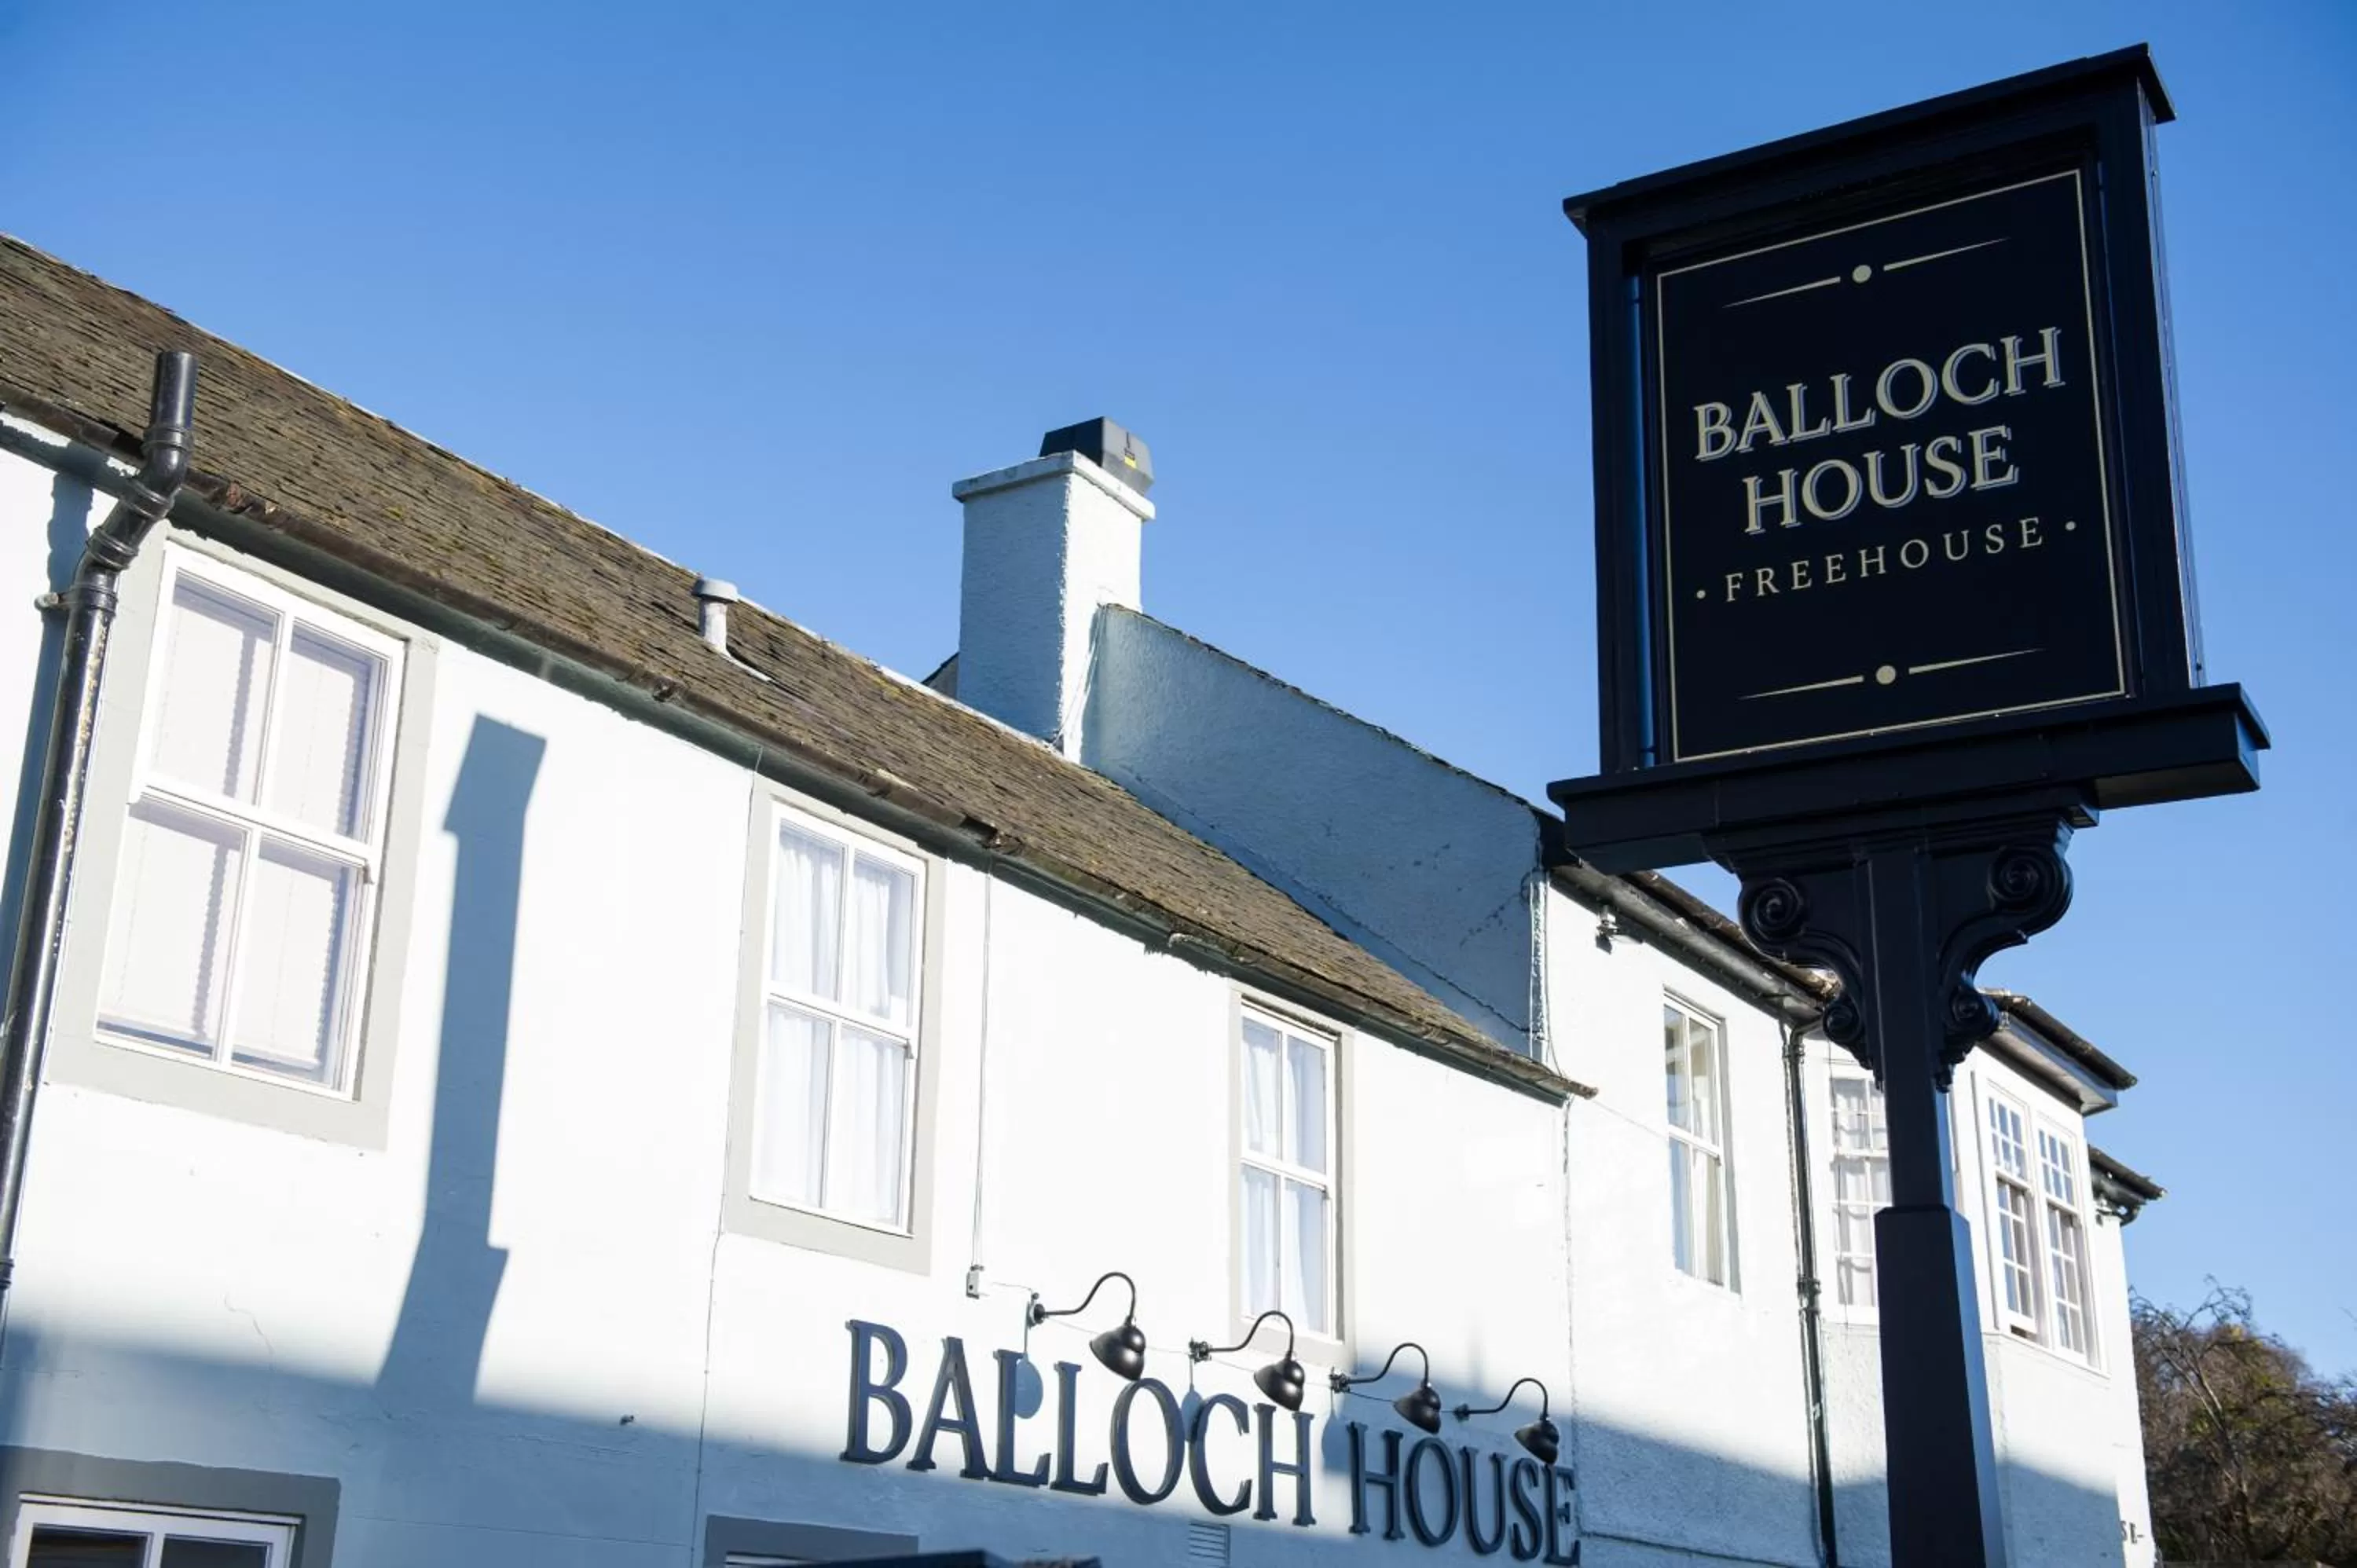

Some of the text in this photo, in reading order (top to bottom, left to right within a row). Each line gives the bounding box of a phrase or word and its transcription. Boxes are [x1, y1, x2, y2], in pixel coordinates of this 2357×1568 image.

[1693, 326, 2066, 462] BALLOCH
[1743, 425, 2019, 533] HOUSE
[1725, 517, 2043, 602] FREEHOUSE
[839, 1320, 1580, 1566] BALLOCH HOUSE
